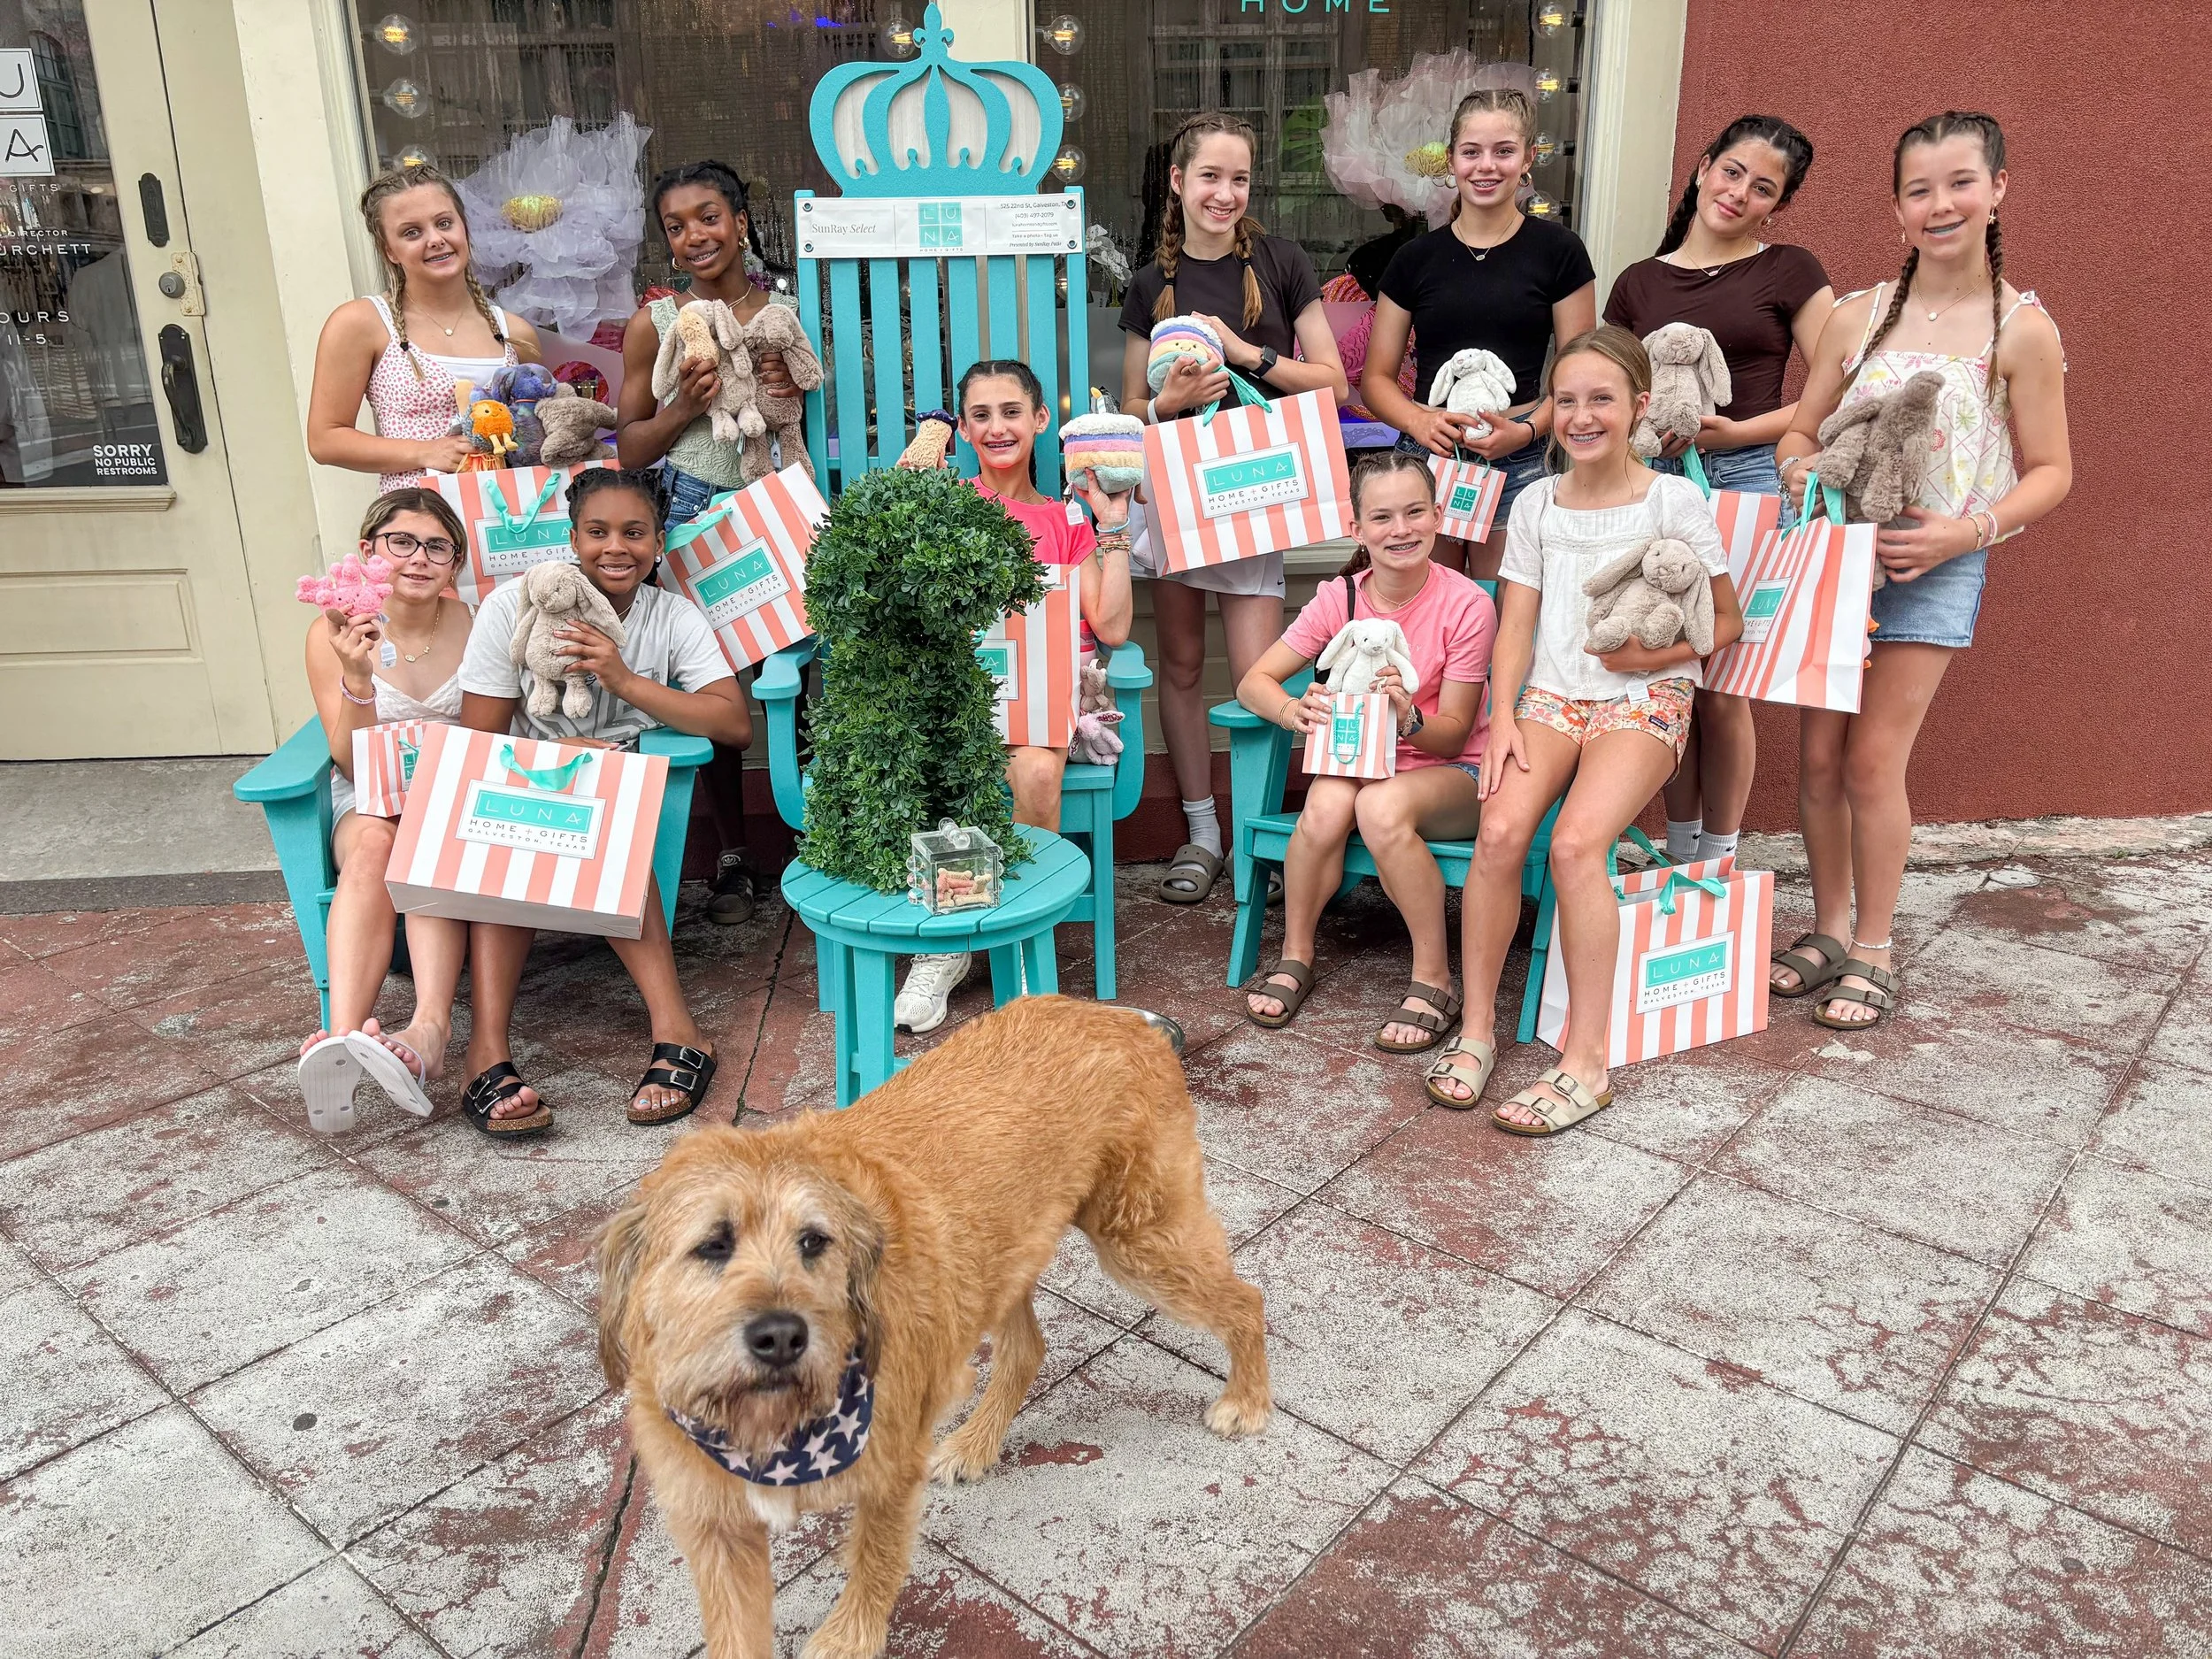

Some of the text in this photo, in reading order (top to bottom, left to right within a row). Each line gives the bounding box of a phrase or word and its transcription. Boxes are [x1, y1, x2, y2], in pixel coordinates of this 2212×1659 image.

[1240, 0, 1390, 13] HOME
[811, 223, 876, 234] SunRay Select
[93, 444, 152, 457] SORRY
[95, 457, 156, 467] NO PUBLIC
[96, 467, 157, 476] RESTROOMS
[1213, 461, 1288, 486] LUNA
[1209, 491, 1245, 503] HOME
[1262, 480, 1299, 493] GIFTS
[1272, 488, 1300, 497] TEXAS
[495, 526, 571, 545] LUNA
[489, 552, 527, 562] HOME
[546, 547, 569, 556] GIF
[704, 560, 764, 598] LUNA
[708, 597, 736, 616] HOME
[748, 574, 778, 595] GIFTS
[758, 583, 781, 597] TEXAS
[485, 799, 582, 825] LUNA
[470, 819, 517, 833] HOME
[540, 830, 588, 843] GIFTS
[549, 841, 586, 850] TEXAS
[1653, 952, 1720, 979] LUNA
[1644, 984, 1678, 997] HOME
[1693, 972, 1725, 986] GIFTS
[1701, 980, 1725, 990] TEXAS
